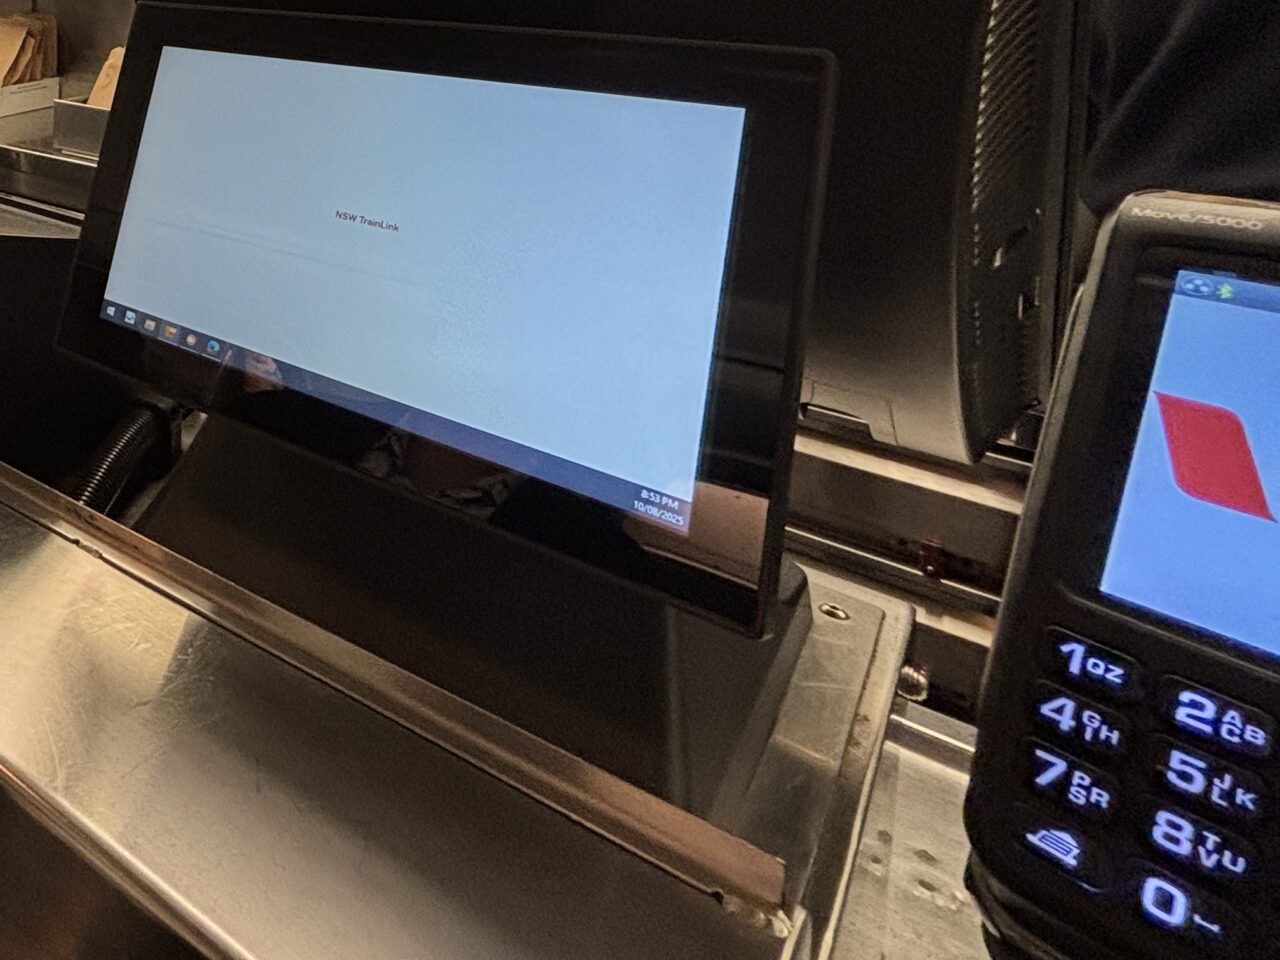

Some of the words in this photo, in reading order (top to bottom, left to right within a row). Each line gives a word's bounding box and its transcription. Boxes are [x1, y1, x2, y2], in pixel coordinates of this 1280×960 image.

[335, 210, 357, 222] NSW
[359, 215, 399, 232] TrainLink
[661, 496, 679, 510] PM
